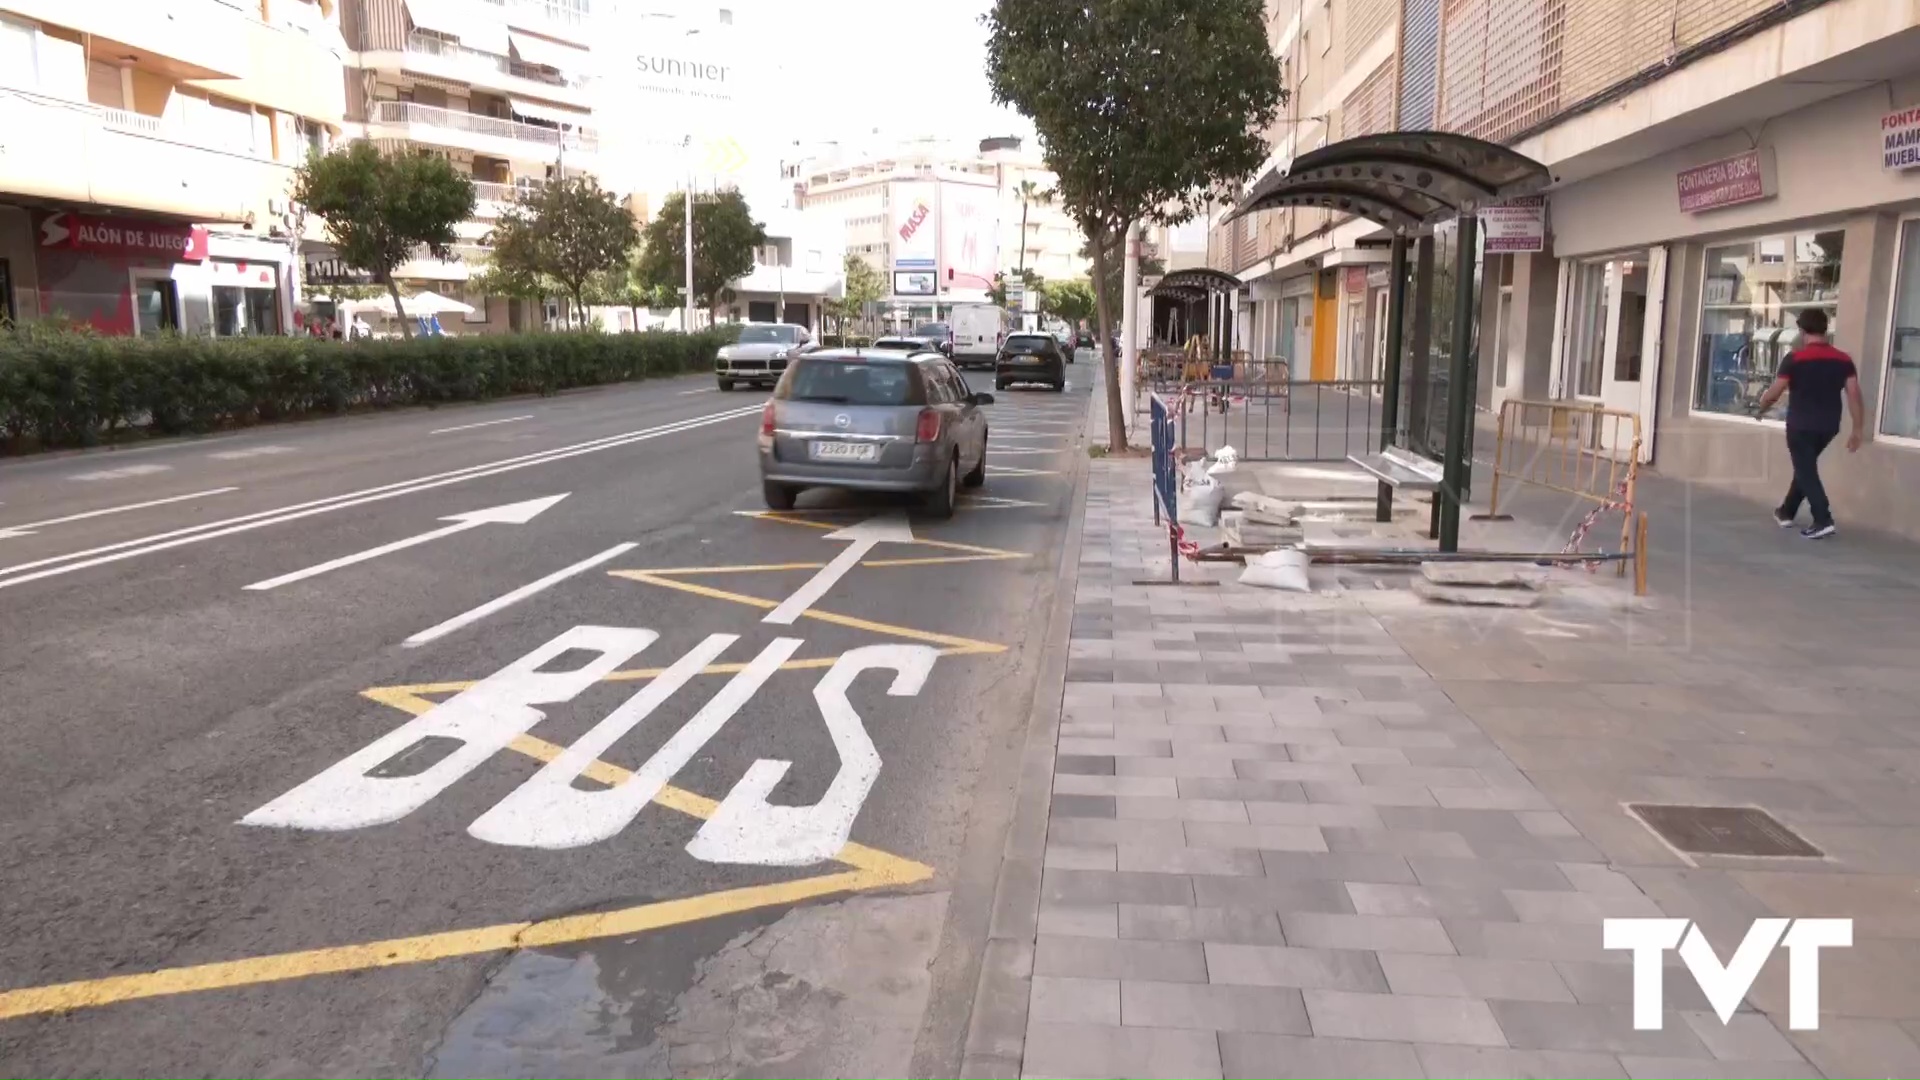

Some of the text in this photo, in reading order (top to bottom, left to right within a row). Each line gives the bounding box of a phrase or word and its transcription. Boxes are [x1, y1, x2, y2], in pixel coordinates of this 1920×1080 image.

[636, 55, 731, 83] sunnier
[1680, 156, 1758, 191] FONTANERIA BOSCH
[125, 230, 144, 246] DE
[899, 202, 930, 242] MASA
[234, 625, 939, 867] BUS
